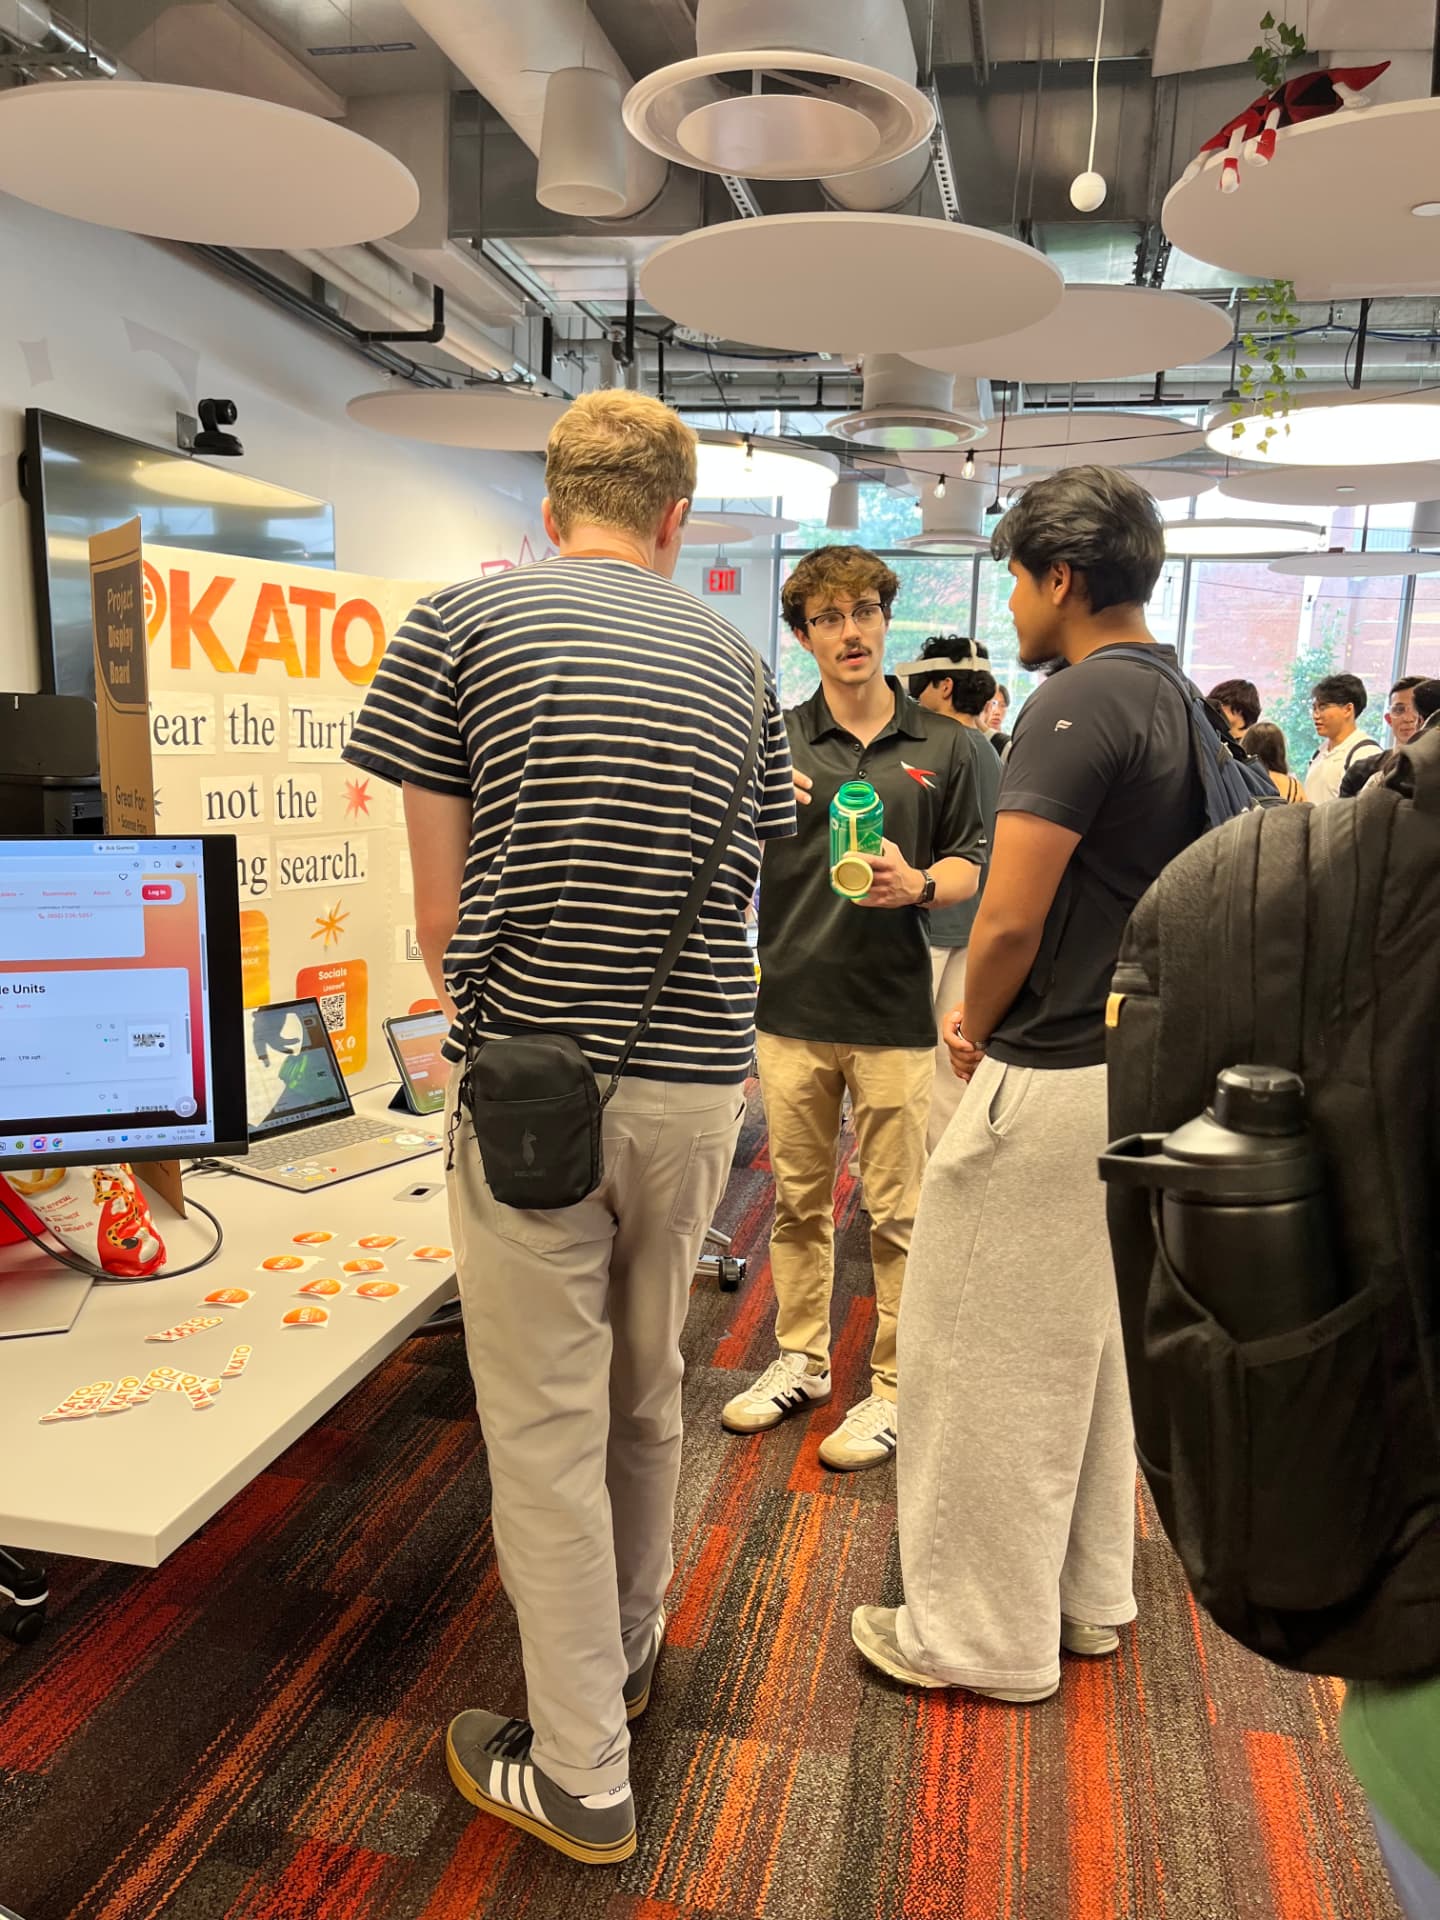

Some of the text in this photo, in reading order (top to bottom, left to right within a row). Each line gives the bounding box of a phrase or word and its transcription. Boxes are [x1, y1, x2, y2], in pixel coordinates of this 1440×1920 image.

[709, 569, 736, 592] EXIT
[107, 584, 133, 620] Project
[108, 624, 133, 652] Display
[169, 568, 386, 686] KATO
[110, 660, 130, 684] Board
[149, 701, 207, 746] ear
[228, 702, 275, 746] the
[206, 779, 317, 820] not the
[280, 841, 365, 885] search.
[318, 967, 347, 981] Socials
[13, 983, 46, 995] Units
[228, 1346, 251, 1371] KATO
[54, 1387, 92, 1414] KATO
[107, 1379, 139, 1407] KATO
